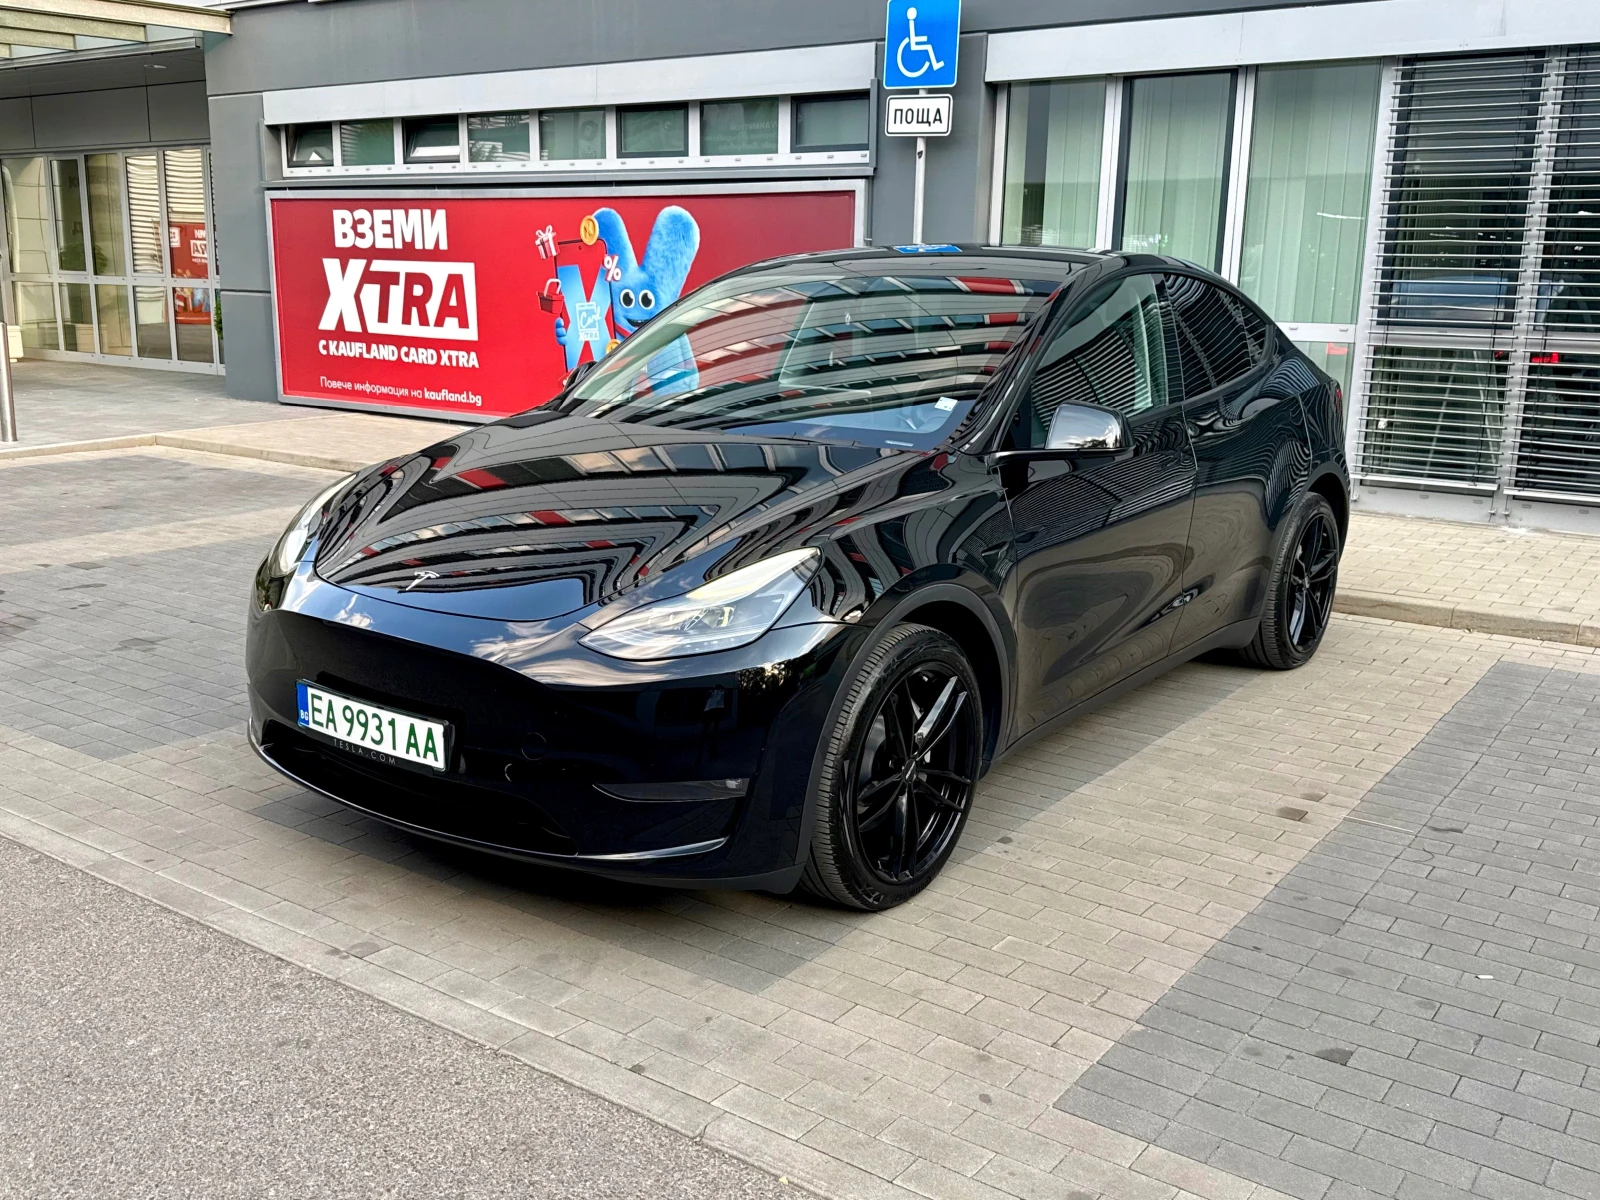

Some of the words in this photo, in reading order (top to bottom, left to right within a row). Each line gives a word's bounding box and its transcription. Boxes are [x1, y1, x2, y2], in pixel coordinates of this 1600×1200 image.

[893, 107, 943, 127] ПОЩА
[332, 208, 448, 250] ВЗЕМИ
[318, 258, 472, 335] XTRA
[328, 340, 398, 361] KAUFLAND
[400, 346, 437, 366] CARD
[440, 350, 479, 368] XTRA
[320, 376, 352, 390] Повече
[354, 381, 408, 397] информация
[411, 389, 422, 398] на
[424, 387, 482, 407] kaufland.bg
[300, 709, 308, 721] BG
[310, 692, 338, 733] EA
[342, 704, 397, 751] 9931
[405, 722, 439, 762] AA
[333, 738, 396, 765] TESLA.COM
